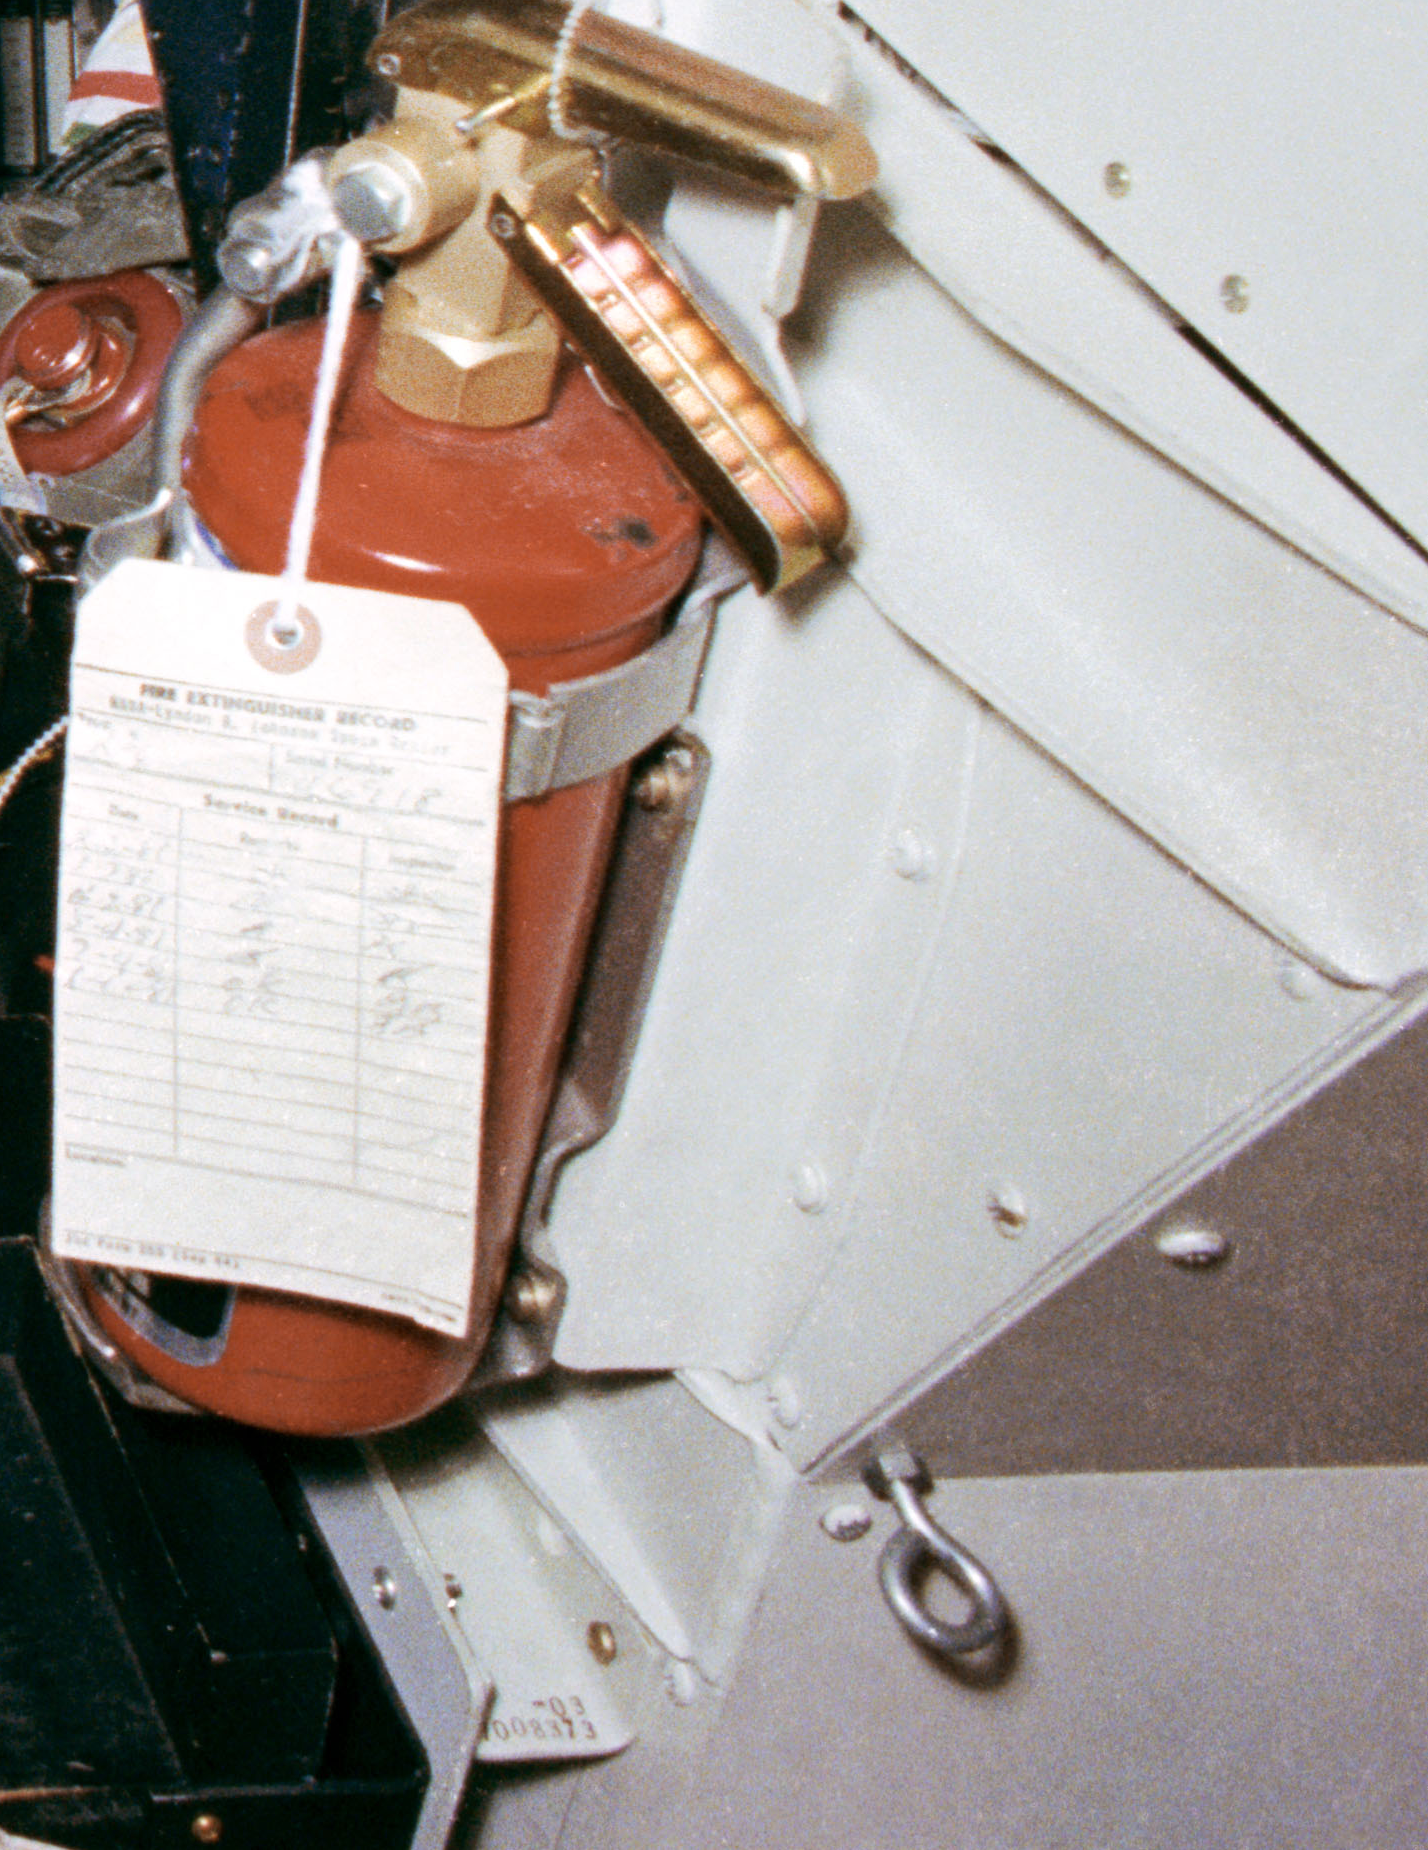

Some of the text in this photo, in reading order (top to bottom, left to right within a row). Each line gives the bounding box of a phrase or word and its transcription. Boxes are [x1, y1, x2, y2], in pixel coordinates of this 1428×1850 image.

[140, 683, 416, 732] FIRE EXTINGUISHER RECORD
[334, 756, 394, 776] Number
[109, 804, 139, 822] Date
[203, 793, 340, 829] Service Record
